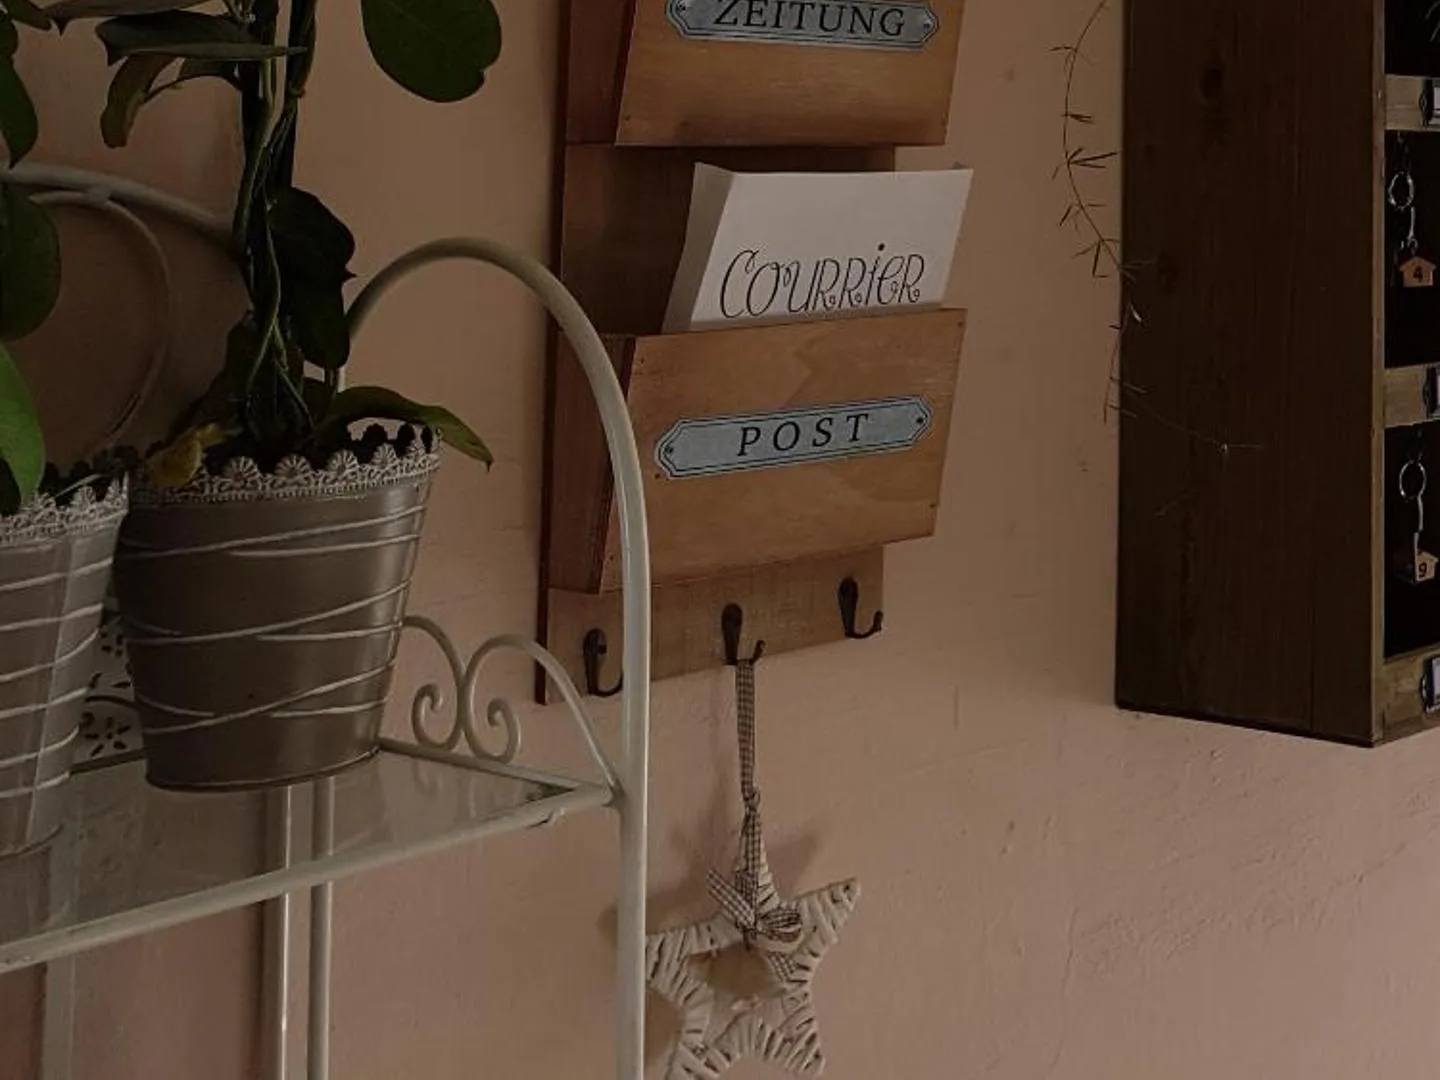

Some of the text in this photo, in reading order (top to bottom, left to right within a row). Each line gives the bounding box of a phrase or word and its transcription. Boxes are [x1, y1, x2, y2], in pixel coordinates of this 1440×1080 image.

[1412, 265, 1423, 284] 4
[737, 413, 869, 456] POST
[1418, 562, 1427, 578] 9
